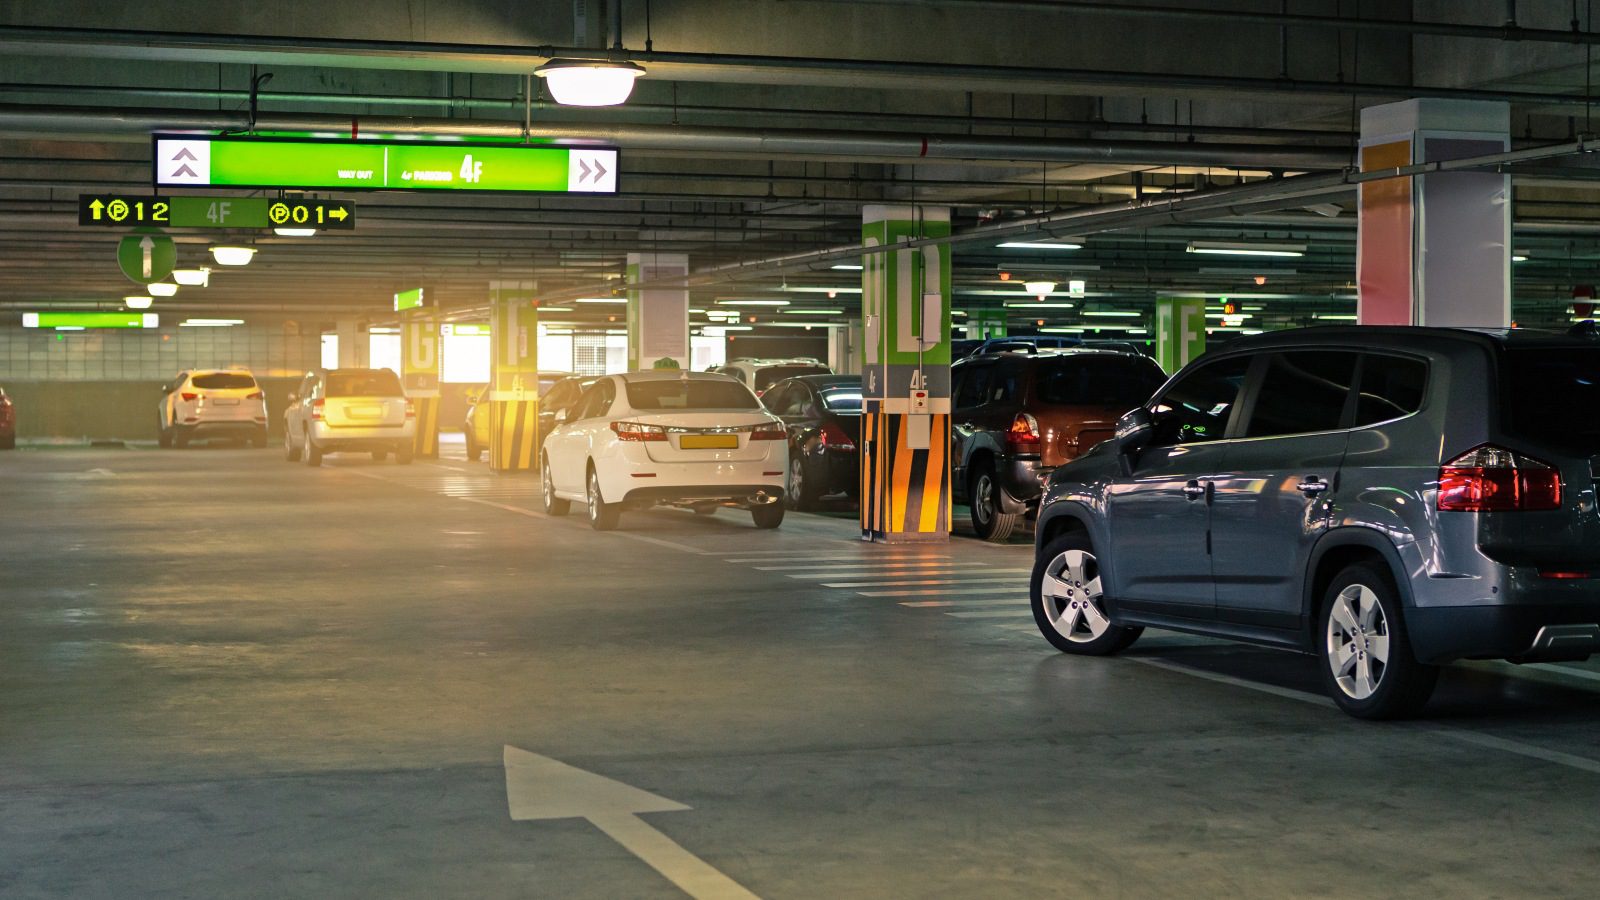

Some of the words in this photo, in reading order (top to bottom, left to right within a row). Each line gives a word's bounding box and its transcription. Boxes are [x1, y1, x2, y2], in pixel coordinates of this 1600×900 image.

[337, 169, 356, 179] WAY
[356, 170, 373, 180] OUT
[459, 154, 483, 183] 4F
[206, 202, 231, 223] 4F
[1180, 304, 1197, 368] F
